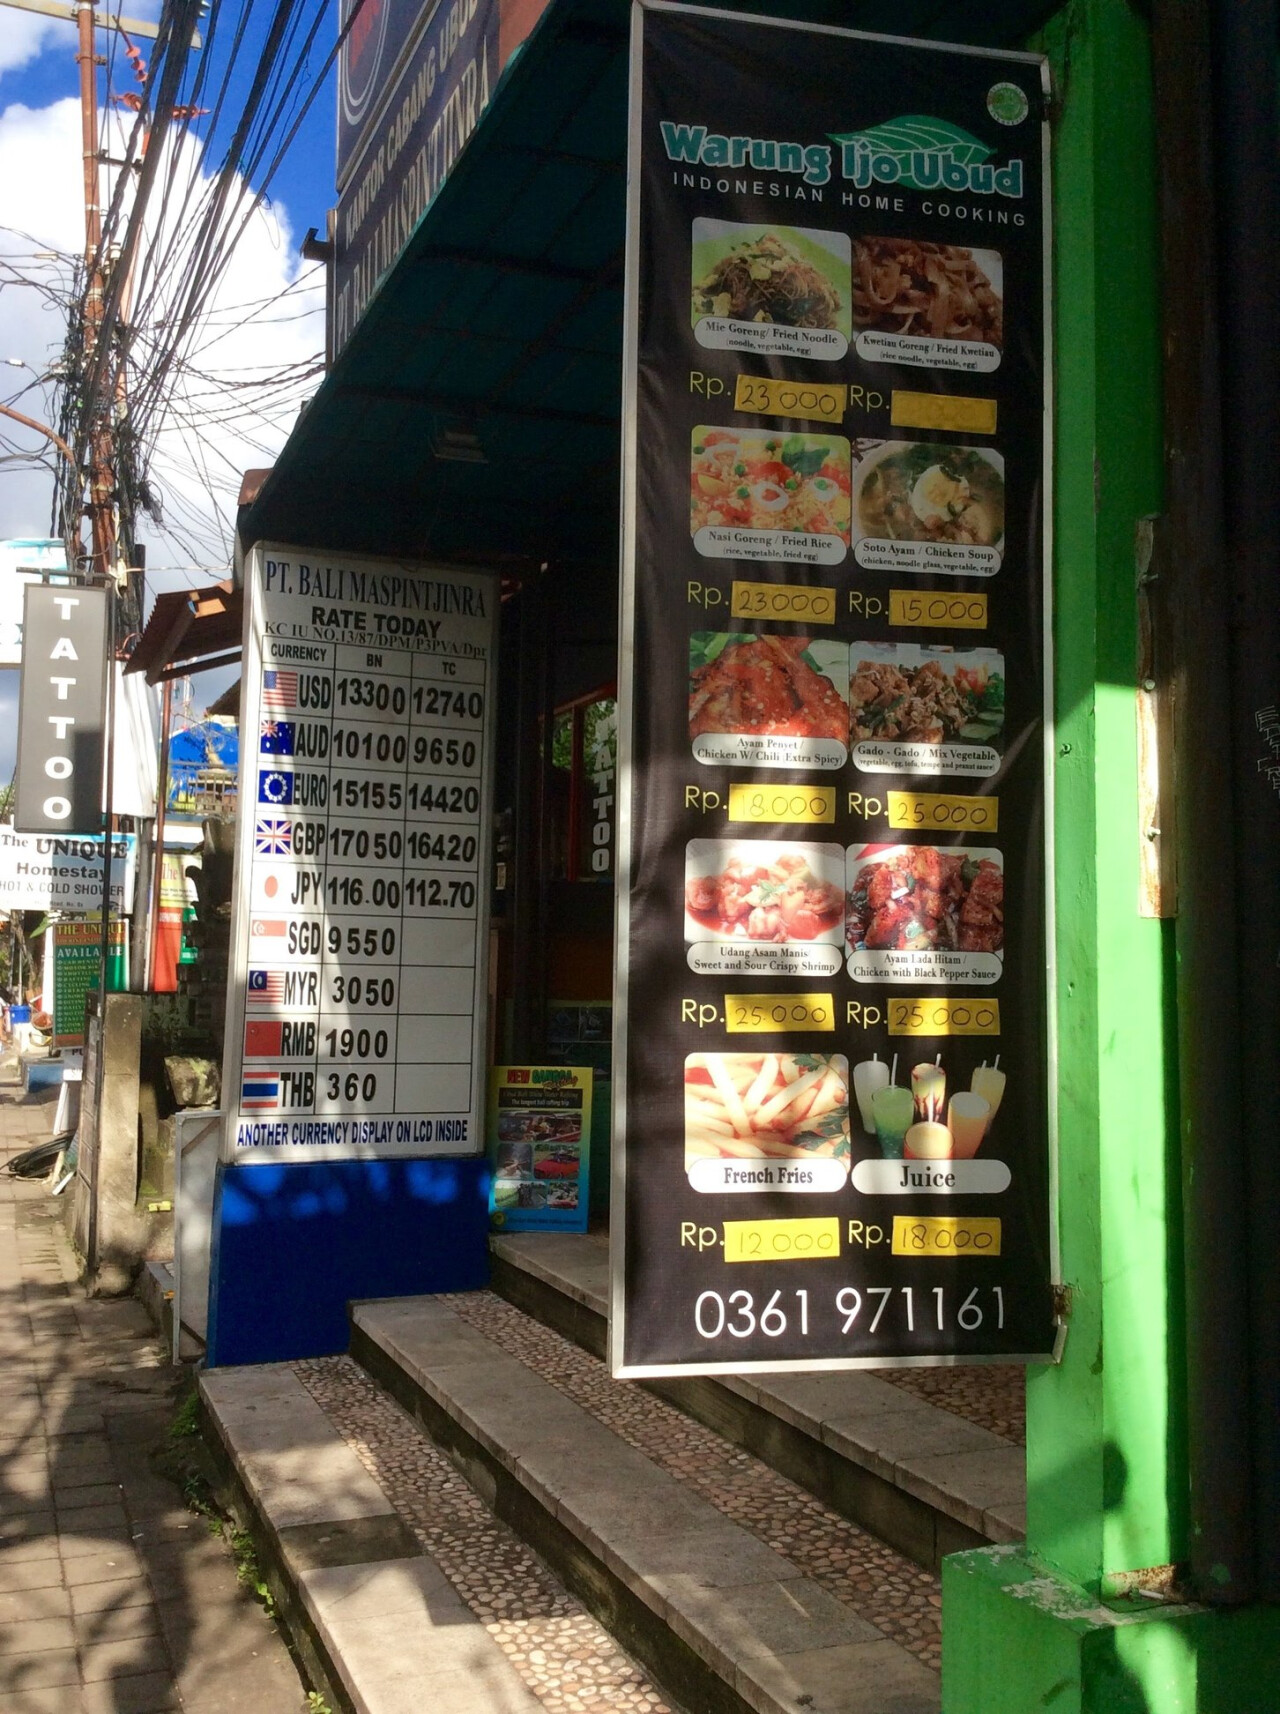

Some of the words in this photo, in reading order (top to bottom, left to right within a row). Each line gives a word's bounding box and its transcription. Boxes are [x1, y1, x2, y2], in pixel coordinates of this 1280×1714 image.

[388, 46, 436, 172] CABANG
[660, 121, 832, 186] Warung
[842, 139, 900, 189] Ijo
[912, 151, 1023, 198] Ubud
[673, 172, 823, 202] INDONESIAN
[842, 192, 904, 212] HOME
[922, 202, 1025, 226] COOKING
[706, 321, 726, 332] Mie
[773, 328, 798, 341] Fried
[801, 332, 838, 344] Noodle
[863, 335, 897, 348] Kwetiau
[899, 340, 930, 353] Goreng
[937, 344, 958, 354] Fried
[961, 346, 994, 358] Kwetiau
[690, 371, 731, 399] Rp.
[850, 385, 890, 412] Rp.
[709, 531, 731, 542] Nasi
[734, 533, 772, 546] Goreng
[782, 536, 807, 547] Fried
[811, 539, 833, 549] Rice
[863, 542, 886, 553] Soto
[888, 544, 915, 557] Ayam
[925, 546, 965, 558] Chicken
[968, 550, 994, 561] Soup
[784, 551, 802, 559] fried
[265, 560, 293, 594] PT.
[299, 564, 344, 600] BALI
[350, 571, 487, 618] MASPINTJINRA
[688, 581, 729, 609] Rp.
[850, 591, 889, 619] Rp.
[311, 606, 367, 631] RATE
[374, 614, 442, 639] TODAY
[271, 643, 327, 662] CURRENCY
[366, 653, 383, 668] BN
[442, 661, 456, 676] TC
[43, 597, 79, 820] TATTOO
[299, 674, 332, 710] USD
[337, 677, 406, 716] 13300
[412, 686, 483, 719] 12740
[295, 723, 329, 759] AUD
[333, 729, 406, 763] 10100
[413, 736, 476, 768] 9650
[697, 748, 737, 759] Chicken
[756, 751, 780, 761] Chili
[814, 754, 843, 766] Spicy)
[737, 738, 763, 750] Ayam
[858, 746, 884, 756] Gado
[893, 748, 919, 758] Gado
[929, 749, 948, 758] Mix
[950, 750, 996, 761] Vegetable
[293, 772, 328, 808] EURO
[332, 778, 402, 811] 15155
[408, 782, 479, 814] 14420
[685, 785, 728, 814] Rp.
[848, 792, 888, 820] Rp.
[2, 834, 28, 847] The
[36, 838, 128, 861] UNIQUE
[292, 821, 326, 857] GBP
[329, 828, 401, 859] 17050
[407, 831, 476, 863] 16420
[16, 862, 106, 882] Homestay
[39, 882, 70, 894] COLD
[291, 871, 322, 905] JPY
[328, 877, 400, 909] 116.00
[405, 878, 475, 908] 112.70
[57, 924, 78, 935] THE
[83, 923, 123, 936] UNIUE
[288, 921, 321, 956] SGD
[328, 926, 395, 957] 9550
[57, 946, 123, 957] AVAILALE
[720, 946, 750, 959] Udang
[752, 947, 778, 957] Asam
[884, 954, 909, 966] Ayam
[911, 954, 932, 964] Lada
[934, 955, 961, 965] Hitam
[694, 959, 722, 969] Sweet
[724, 960, 742, 970] and
[744, 960, 767, 970] Sour
[769, 960, 799, 973] Crispy
[802, 960, 835, 973] Shrimp
[853, 966, 890, 977] Chicken
[892, 967, 911, 977] with
[914, 967, 937, 978] Black
[939, 968, 970, 981] Pepper
[971, 969, 996, 979] Sauce
[283, 971, 318, 1006] MYR
[332, 976, 394, 1007] 3050
[681, 999, 725, 1028] Rp.
[847, 1001, 888, 1030] Rp.
[281, 1021, 315, 1057] RMB
[325, 1028, 388, 1058] 1900
[280, 1072, 314, 1108] THB
[327, 1072, 376, 1101] 360
[237, 1123, 288, 1146] ANOTHER
[292, 1122, 349, 1145] CURRENCY
[351, 1121, 394, 1144] DISPLAY
[396, 1120, 411, 1142] ON
[413, 1120, 432, 1142] LCD
[435, 1119, 468, 1141] INSIDE
[724, 1167, 773, 1184] French
[777, 1167, 813, 1184] Fries
[900, 1166, 956, 1187] Juice
[681, 1222, 725, 1252] Rp.
[848, 1220, 891, 1249] Rp.
[694, 1289, 809, 1339] 0361
[835, 1286, 1005, 1334] 971161
